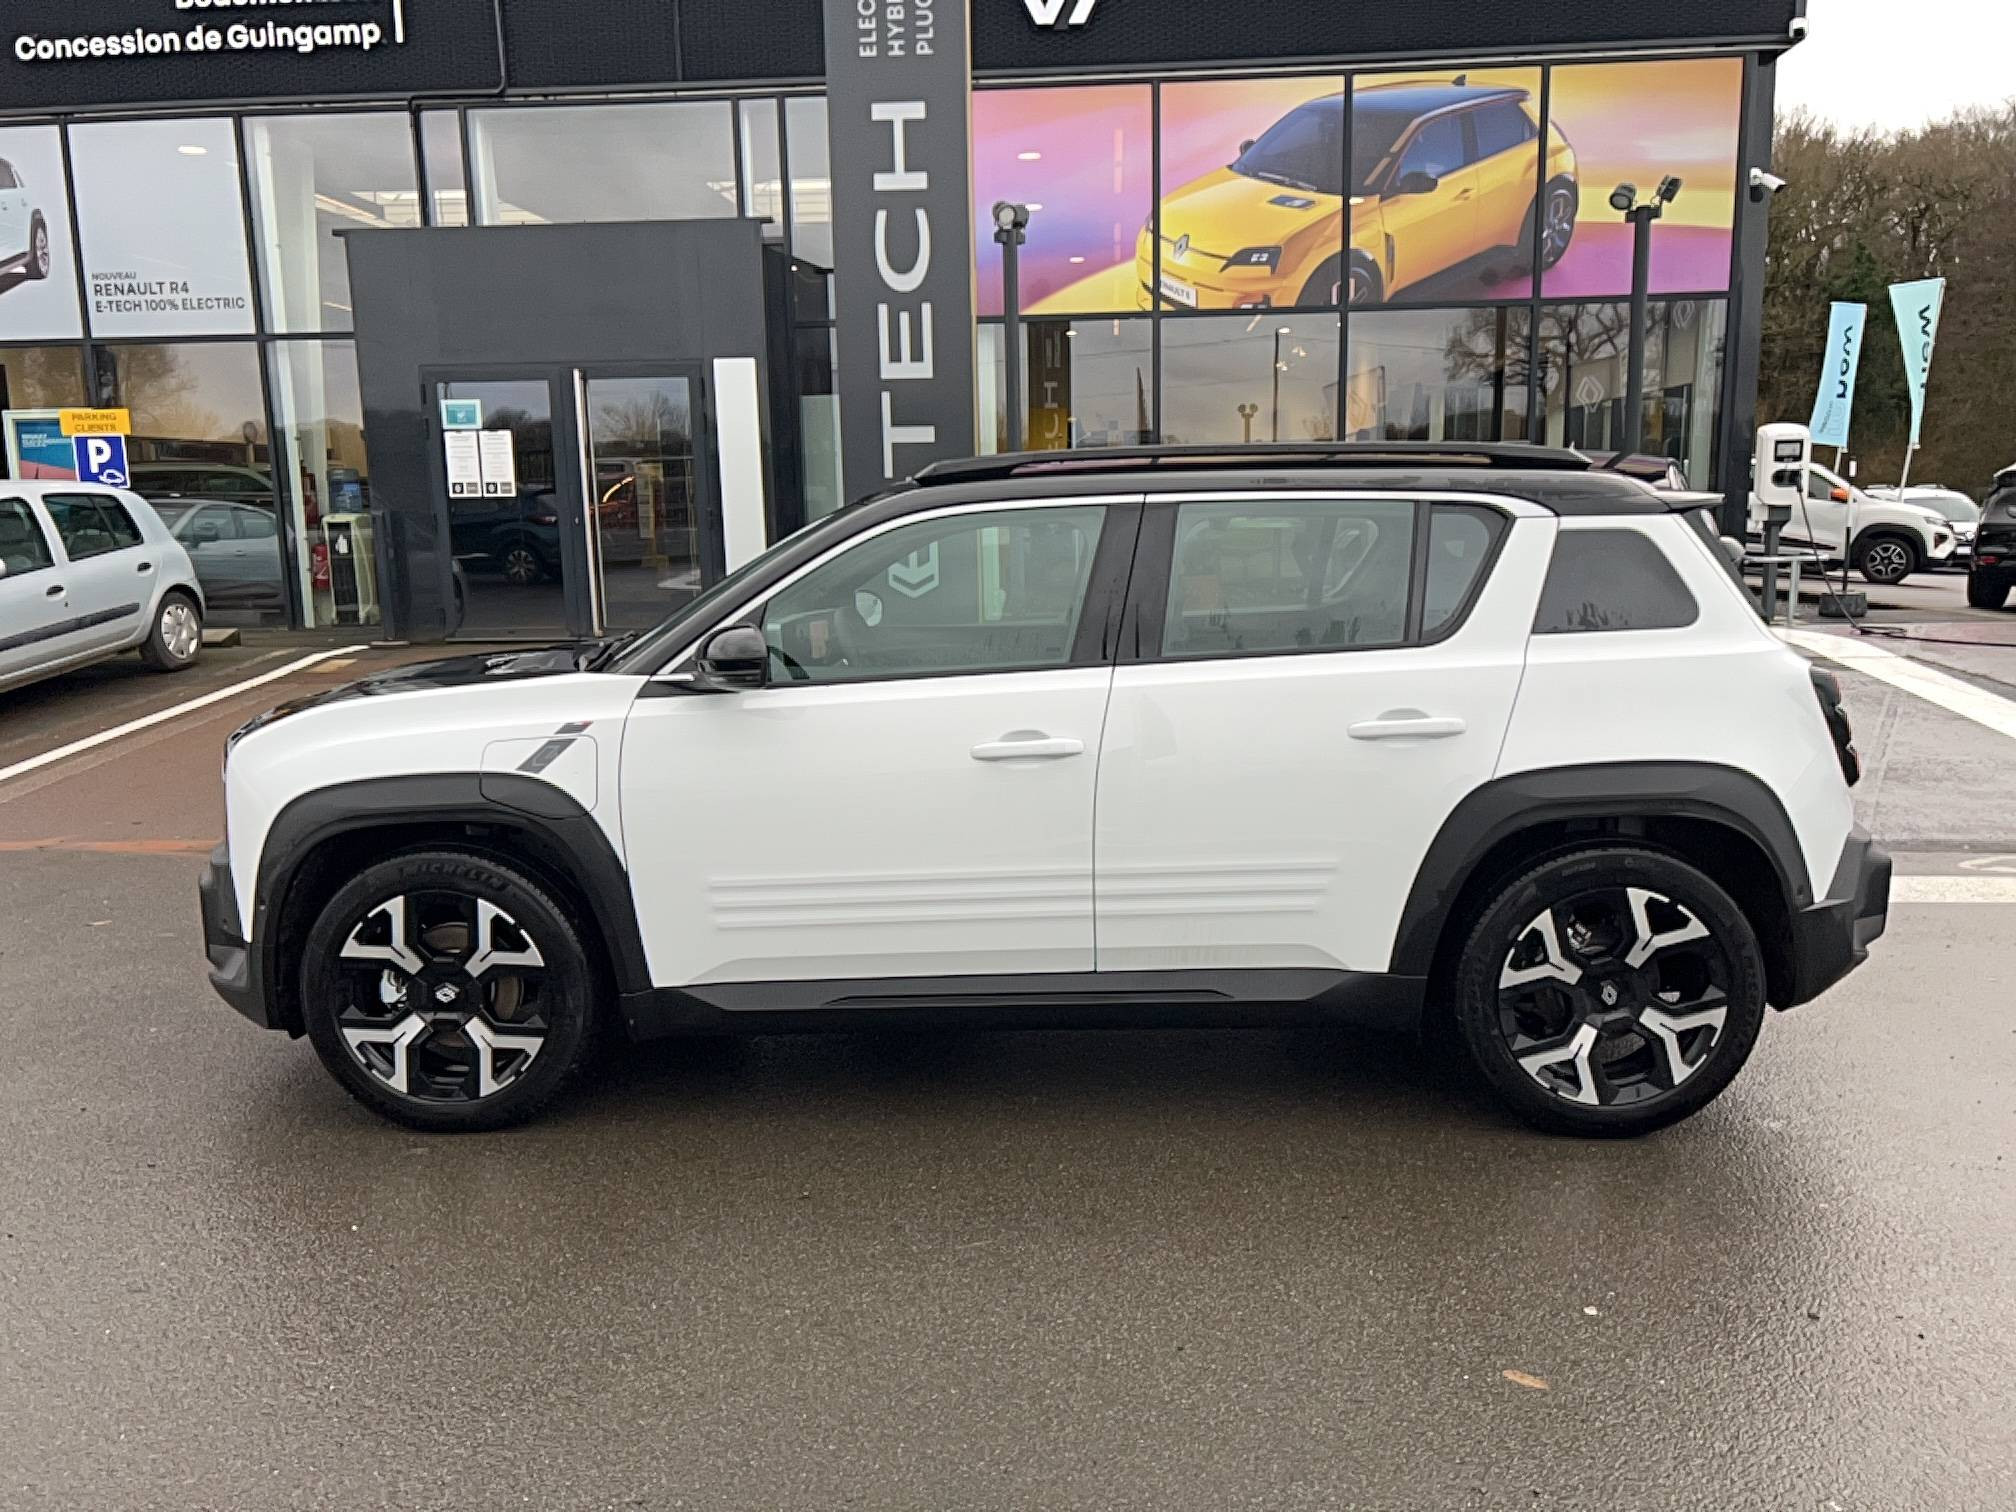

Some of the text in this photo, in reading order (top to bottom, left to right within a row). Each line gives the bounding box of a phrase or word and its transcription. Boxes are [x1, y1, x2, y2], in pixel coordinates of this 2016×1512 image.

[886, 0, 906, 56] HYB
[14, 20, 381, 61] Concession de Guingamp
[91, 272, 137, 280] NOUVEAU
[93, 281, 190, 297] RENAULT R4
[95, 296, 246, 313] E-TECH 100% ELECTRIC
[71, 412, 117, 422] PARKING
[74, 423, 117, 433] CLIENTS
[87, 438, 112, 474] P
